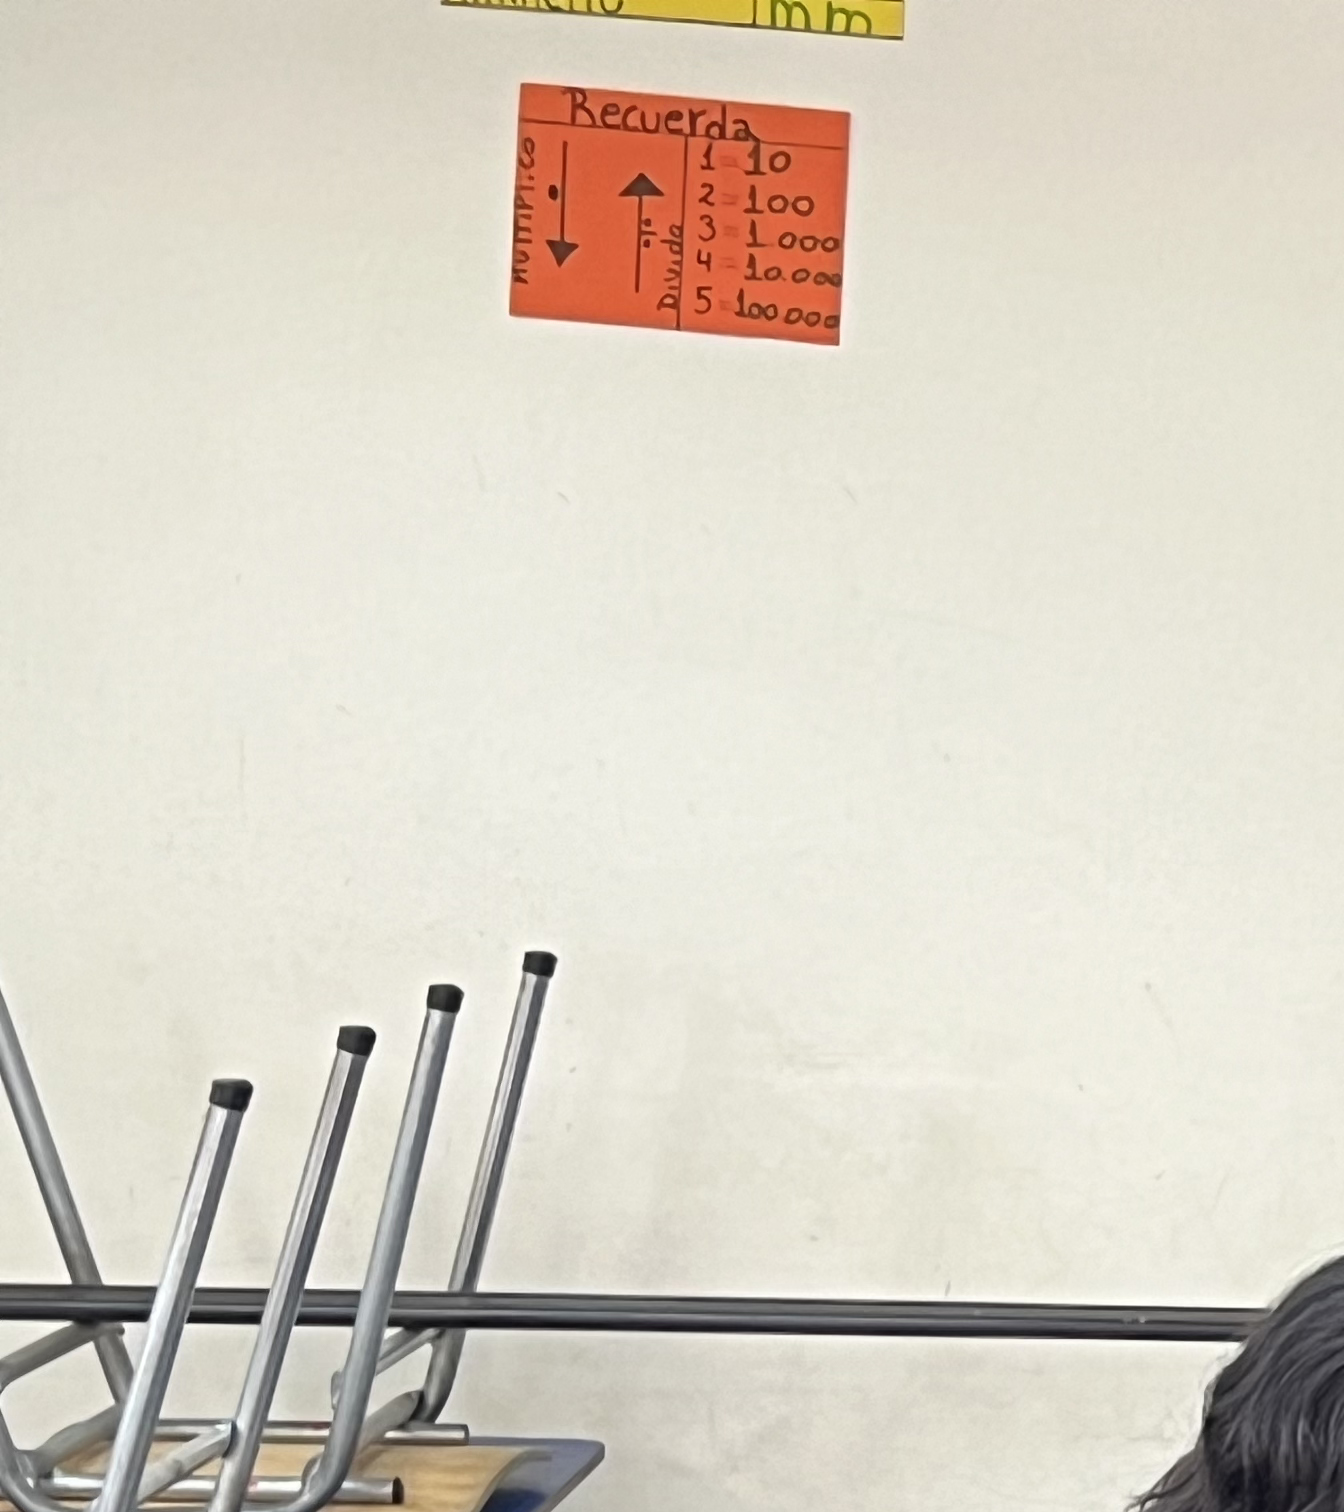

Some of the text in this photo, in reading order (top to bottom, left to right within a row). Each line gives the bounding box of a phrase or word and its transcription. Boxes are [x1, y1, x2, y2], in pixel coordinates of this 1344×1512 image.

[561, 86, 764, 142] Recuerda
[743, 139, 793, 176] 10
[742, 183, 816, 217] 100
